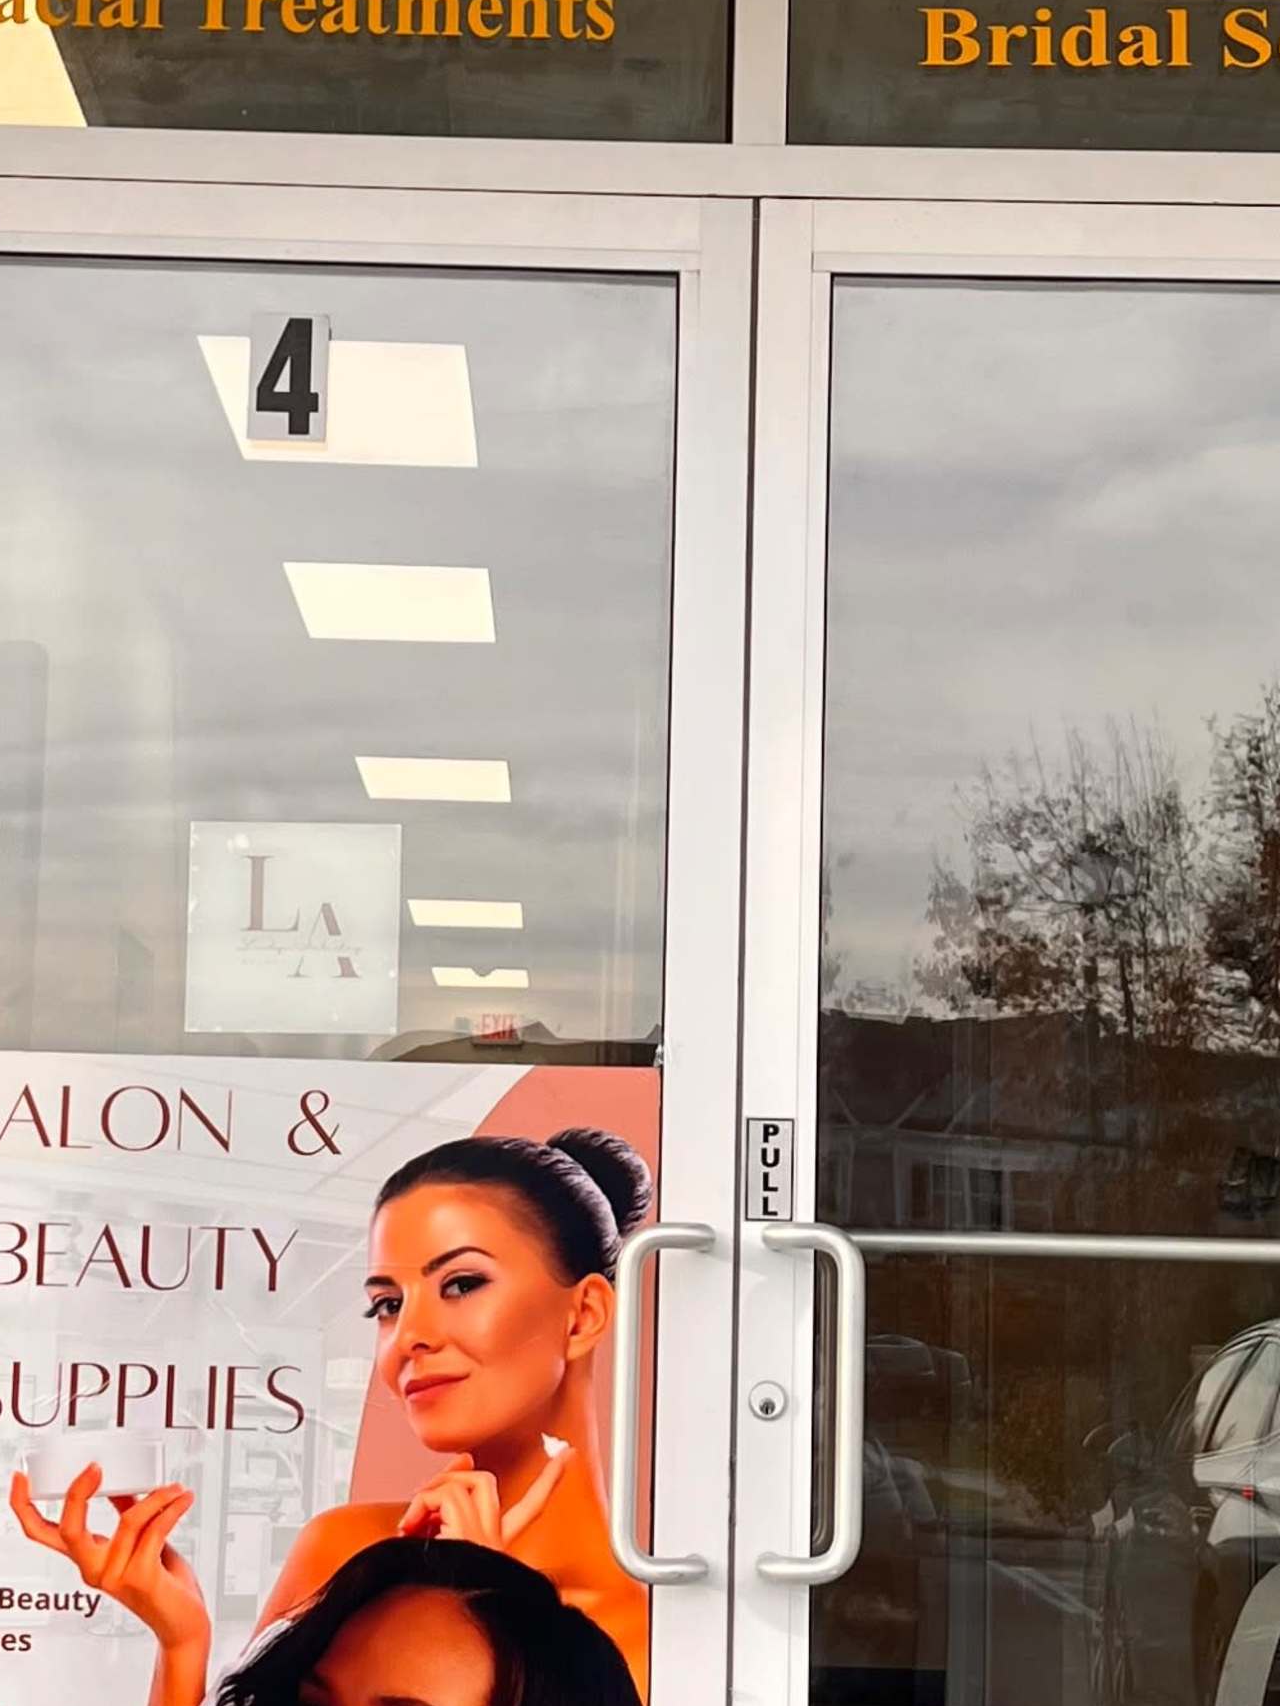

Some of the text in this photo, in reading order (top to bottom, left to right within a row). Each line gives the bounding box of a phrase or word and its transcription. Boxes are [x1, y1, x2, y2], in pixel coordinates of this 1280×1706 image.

[920, 8, 1192, 69] Bridal
[256, 318, 318, 435] 4
[287, 1089, 342, 1156] &
[761, 1124, 780, 1216] PULL
